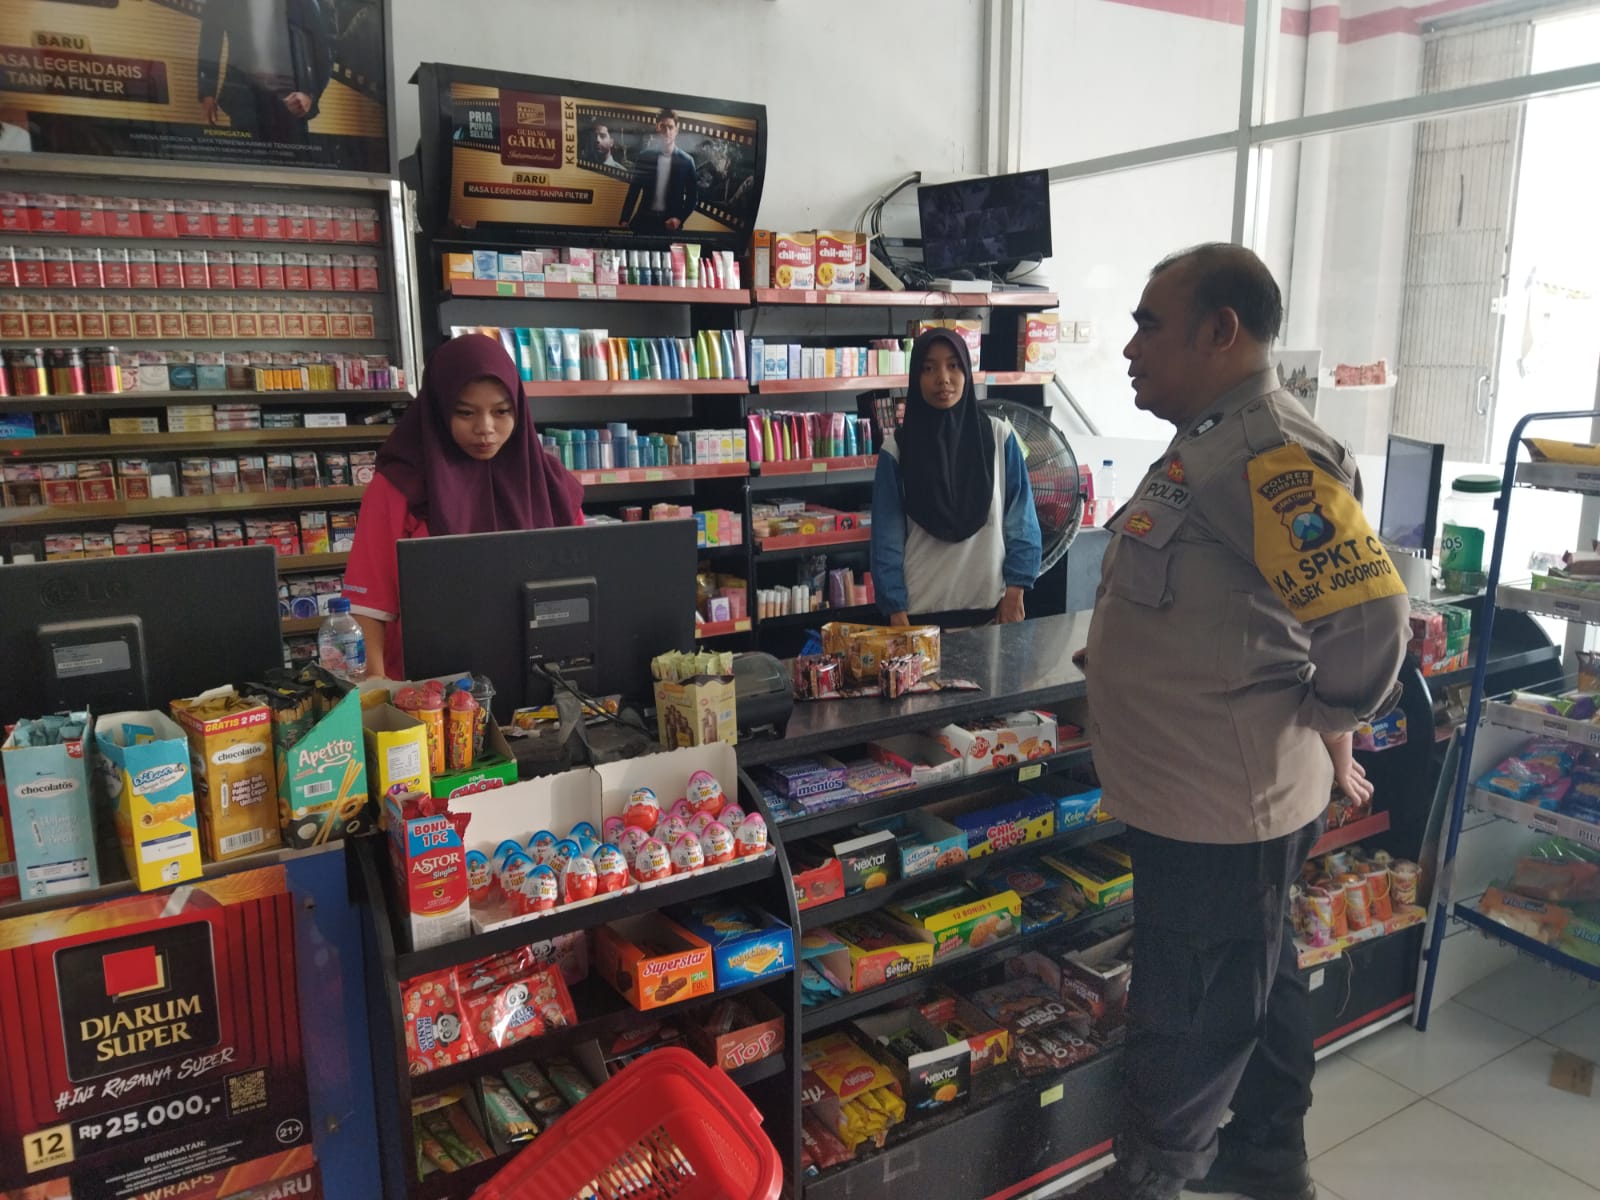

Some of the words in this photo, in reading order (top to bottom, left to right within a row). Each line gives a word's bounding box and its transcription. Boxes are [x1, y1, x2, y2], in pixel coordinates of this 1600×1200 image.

[37, 34, 85, 50] BARU
[33, 56, 143, 80] LEGENDARIS
[7, 71, 66, 90] TANPA
[68, 76, 125, 95] FILTER
[468, 110, 494, 123] PRIA
[507, 134, 557, 150] GARAM
[516, 128, 547, 138] GUDANG
[564, 101, 575, 165] KRETEK
[515, 174, 547, 185] BARU
[468, 184, 491, 194] RASA
[490, 186, 539, 198] LEGENDARIS
[540, 189, 564, 199] TANPA
[564, 191, 589, 200] FILTER
[1145, 483, 1188, 505] POLRI
[1262, 472, 1309, 494] POLRES
[1299, 539, 1361, 580] SPKT
[1366, 535, 1382, 556] C
[1330, 559, 1392, 590] JOGOROTO
[204, 718, 240, 733] GRATIS
[240, 716, 248, 725] 2
[249, 712, 268, 723] PCS
[299, 738, 353, 769] Apetito
[797, 779, 843, 798] mentos
[423, 836, 430, 847] 1
[431, 832, 449, 846] PC
[987, 820, 1016, 839] CHIC
[991, 828, 1026, 849] CHOC
[411, 852, 461, 875] ASTOR
[432, 865, 458, 880] Singles
[643, 950, 707, 977] Superstar
[79, 995, 203, 1041] DJARUM
[96, 1021, 192, 1062] SUPER
[416, 1017, 427, 1051] PANDA
[423, 1016, 435, 1050] HELLO
[101, 1065, 172, 1099] RASANYA
[177, 1047, 235, 1080] SUPER
[78, 1123, 103, 1141] Rp
[106, 1094, 221, 1139] 25.000,-
[279, 1124, 301, 1139] 21+
[30, 1132, 64, 1158] 12
[144, 1139, 207, 1164] PERINGATAN:
[143, 1173, 216, 1200] WRAPS
[256, 1174, 313, 1200] ARU
